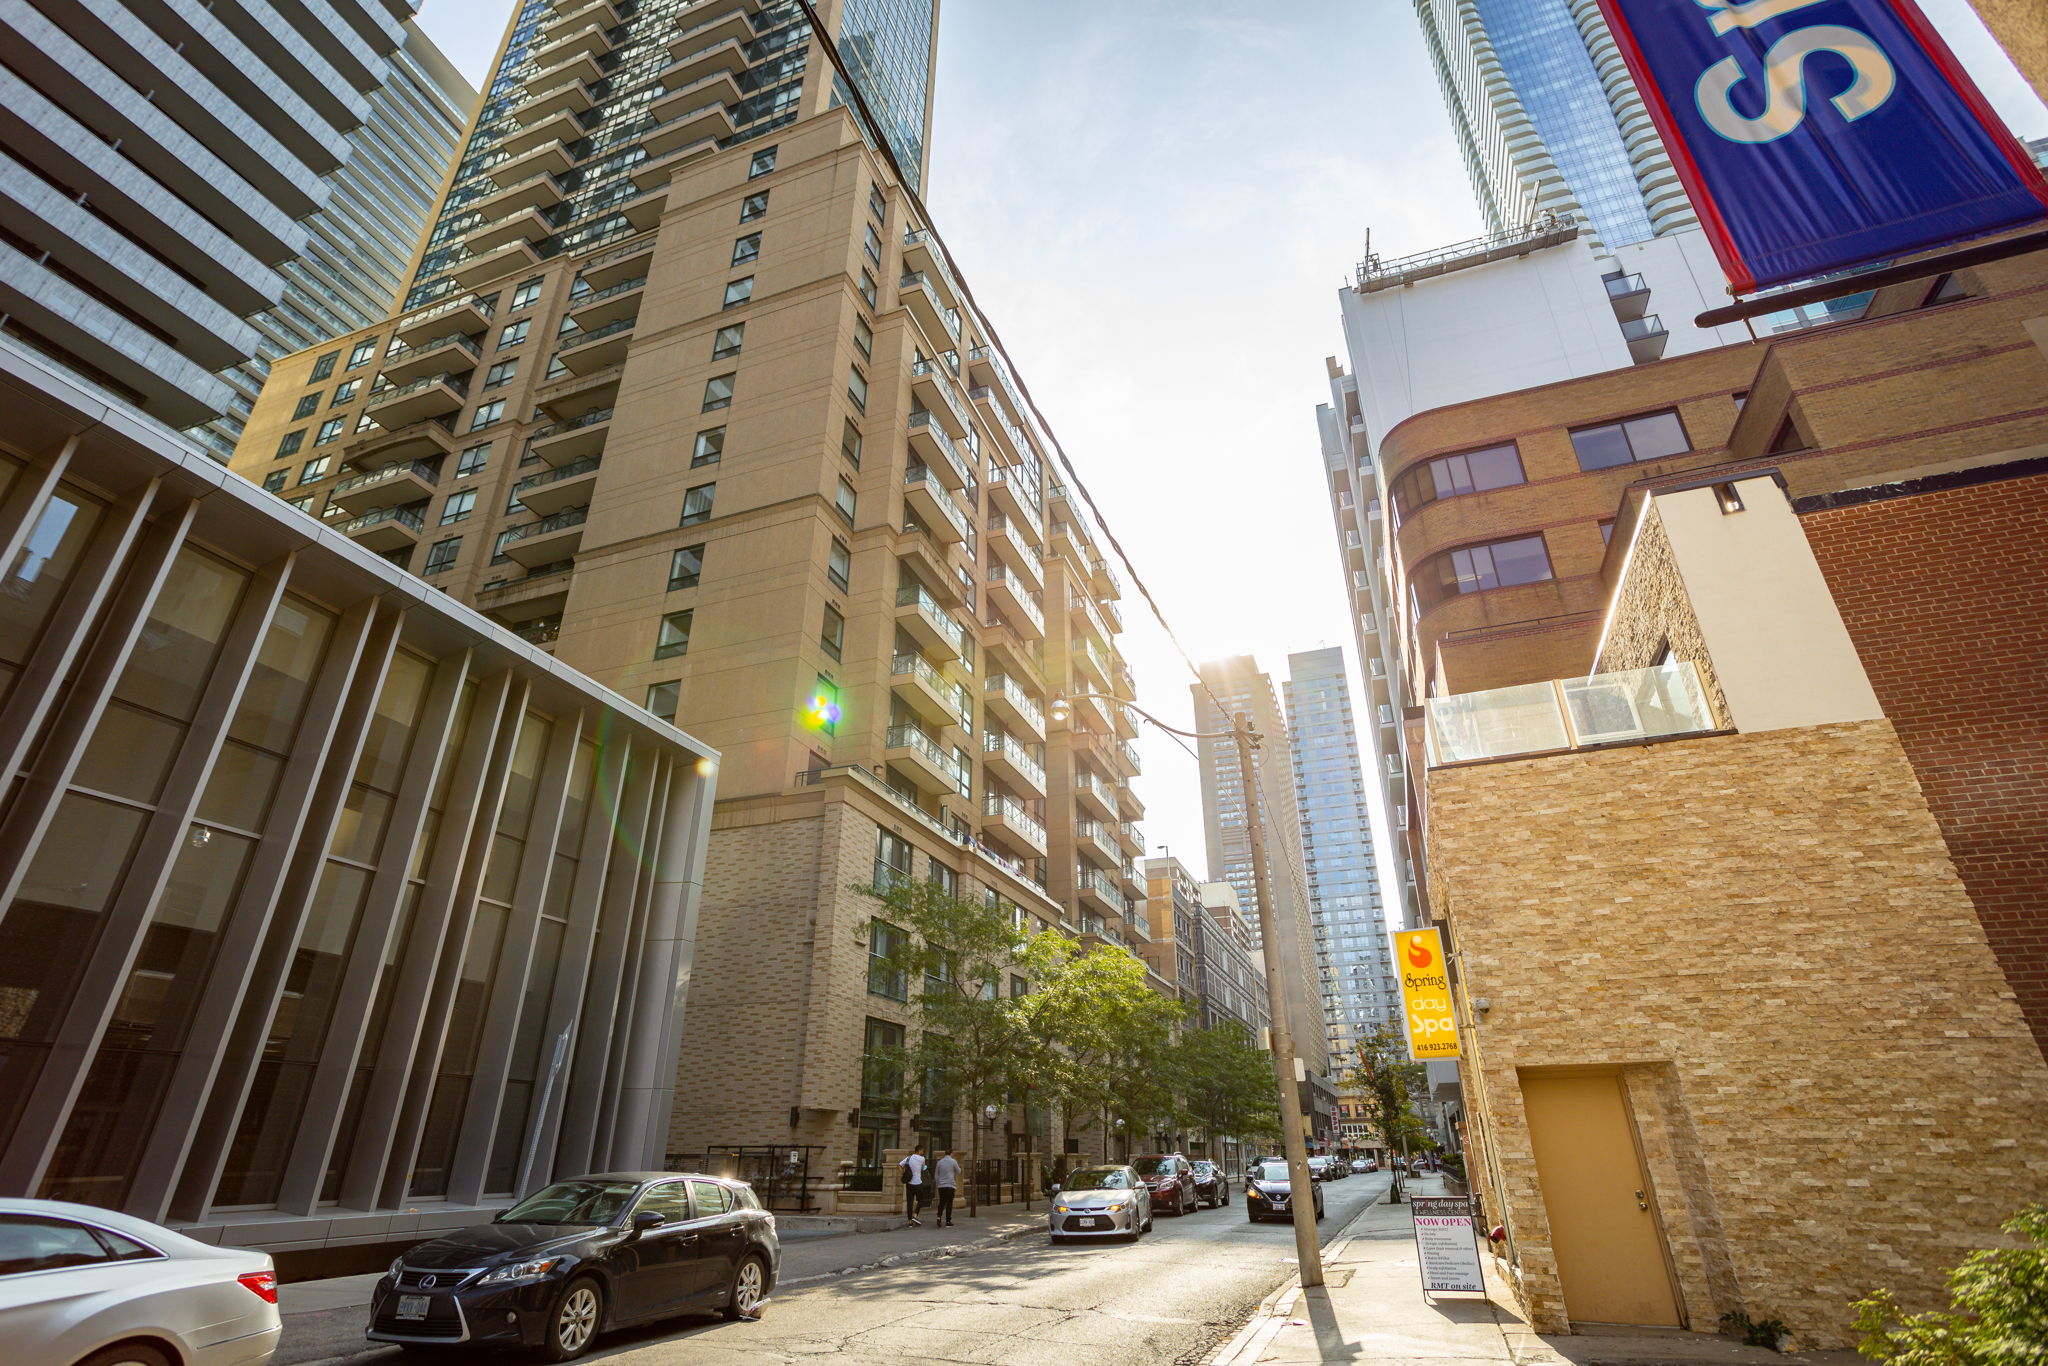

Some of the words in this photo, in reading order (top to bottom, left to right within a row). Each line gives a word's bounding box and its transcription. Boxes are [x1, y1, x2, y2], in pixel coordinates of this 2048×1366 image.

[1693, 0, 1897, 145] S
[1404, 973, 1446, 991] Spring
[1412, 996, 1446, 1012] day
[1412, 1014, 1454, 1038] Spa
[1429, 1043, 1458, 1051] 923.2768
[1412, 1200, 1438, 1210] spring
[1438, 1199, 1454, 1210] day
[1454, 1201, 1468, 1210] spa
[1415, 1218, 1439, 1226] NOW
[1441, 1218, 1471, 1226] OPEN
